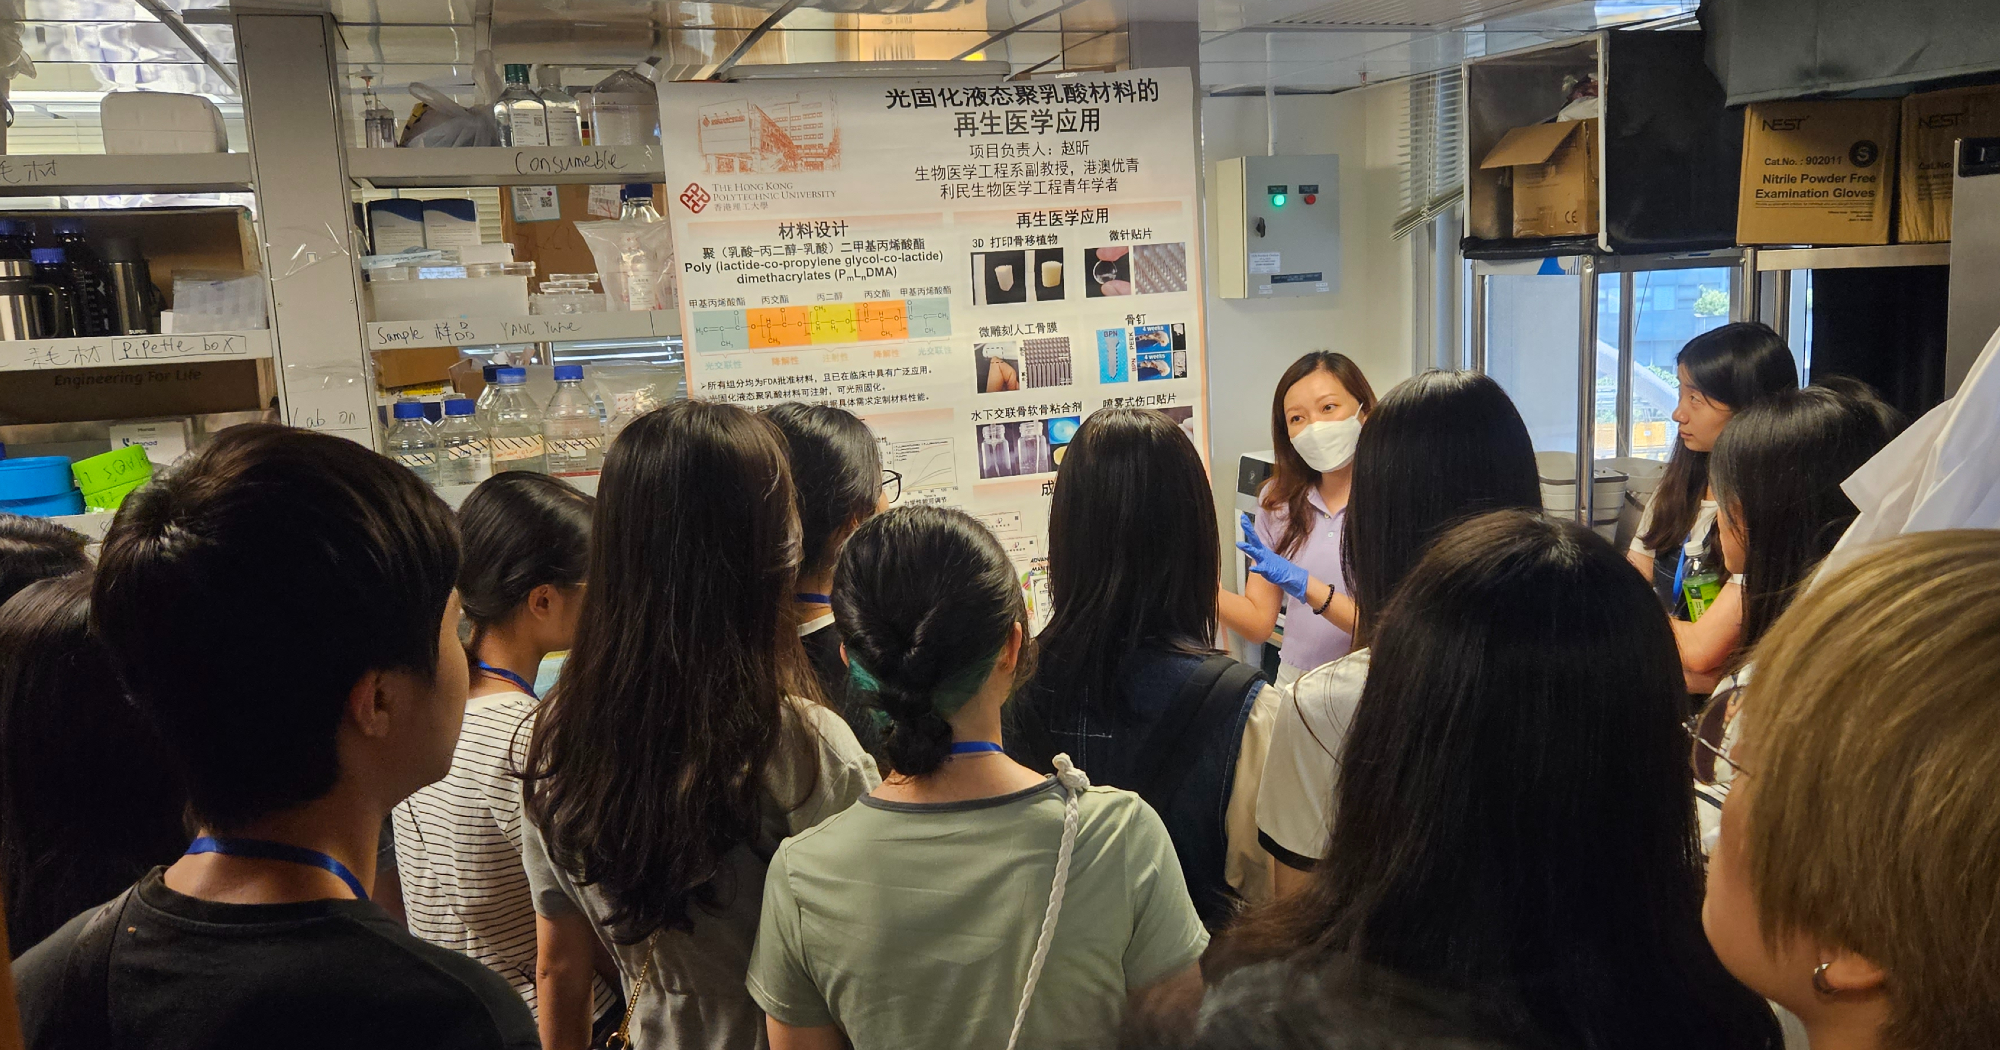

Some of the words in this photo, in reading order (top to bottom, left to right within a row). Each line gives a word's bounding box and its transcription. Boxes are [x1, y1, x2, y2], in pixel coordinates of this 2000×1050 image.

[885, 78, 1160, 109] 光固化液态聚乳酸材料的
[954, 107, 1101, 138] 再生医学应用
[1762, 117, 1808, 131] NEST
[1805, 156, 1842, 165] 902011
[1762, 174, 1797, 184] Nitrile
[1800, 173, 1847, 184] Powder
[1849, 173, 1877, 183] Free
[712, 183, 732, 192] THE
[734, 182, 764, 192] HONG
[766, 182, 793, 190] KONG
[940, 177, 1119, 199] 利民生物医学工程青年学者
[1755, 188, 1829, 199] Examination
[1832, 188, 1876, 198] Gloves
[713, 192, 780, 202] POLYTECHNIC
[781, 190, 837, 200] UNIVERSITY
[714, 202, 769, 212] 香港理工大學
[1016, 207, 1109, 229] 再生医学应用
[778, 220, 849, 240] 材料设计
[1109, 228, 1153, 242] 微针贴片
[972, 238, 984, 248] 3D
[990, 233, 1058, 248] 打印骨移植物
[684, 262, 712, 275] Poly
[716, 255, 842, 274] (lactide-co-propylene
[845, 251, 944, 269] glycol-co-lactide)
[736, 268, 831, 285] dimethacrylates
[864, 289, 891, 299] 丙交酯
[900, 285, 952, 297] 甲基丙烯酸酯
[688, 296, 746, 309] 甲基丙烯酸酯
[761, 294, 789, 305] 丙交酯
[1125, 313, 1146, 326] 骨钉
[377, 326, 424, 344] Sample
[434, 321, 475, 344] 样品
[978, 321, 1058, 338] 微雕刻人工骨膜
[54, 371, 143, 389] Engineering
[149, 371, 170, 384] For
[176, 370, 201, 381] Life
[971, 401, 1082, 421] 水下交联骨软骨粘合剂
